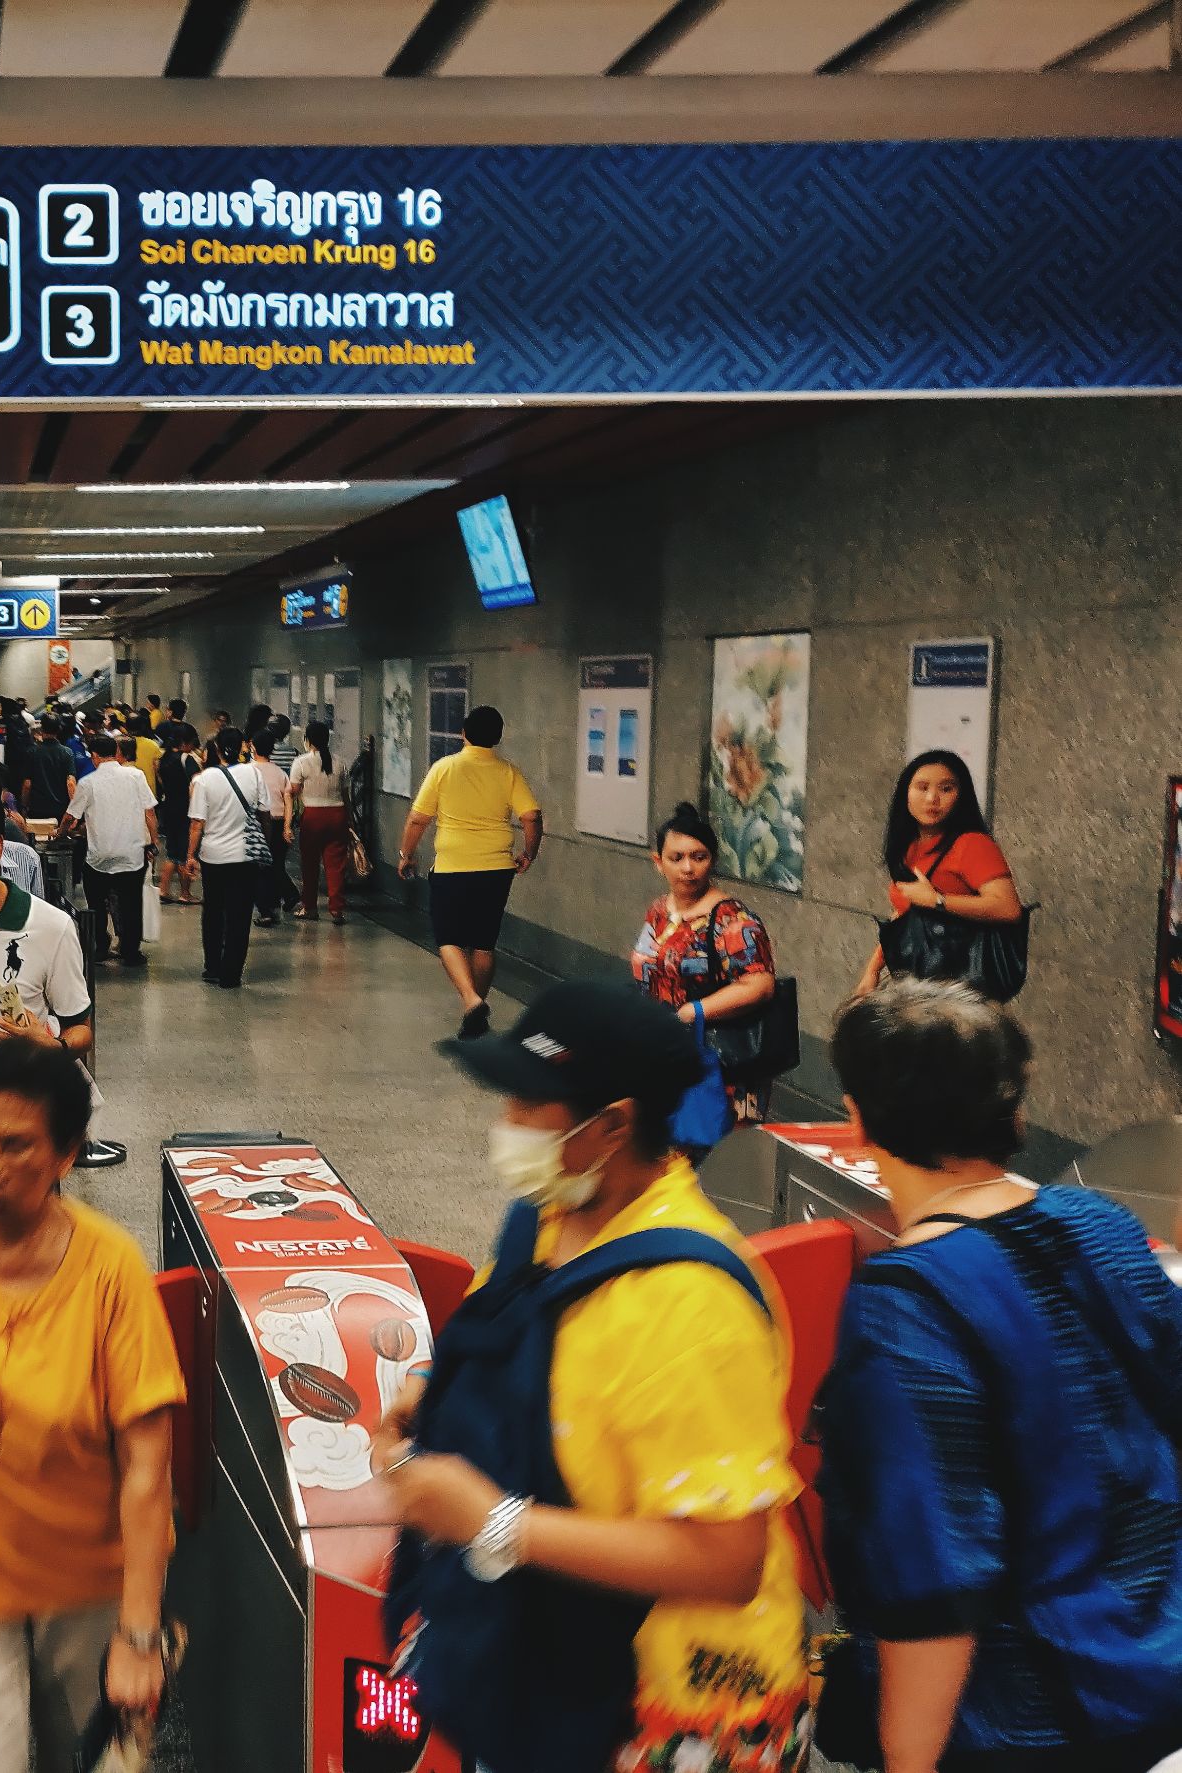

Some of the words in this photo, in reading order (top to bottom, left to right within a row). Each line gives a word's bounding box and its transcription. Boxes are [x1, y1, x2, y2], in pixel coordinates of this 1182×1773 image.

[63, 203, 94, 246] 2
[139, 179, 382, 245] ซอยเจริญกรุง
[398, 187, 442, 226] 16
[139, 239, 186, 264] Soi
[191, 238, 307, 264] Charoen
[313, 239, 396, 271] Krung
[403, 238, 437, 264] 16
[139, 280, 454, 327] วัดมังกรกมลาวาส
[65, 304, 95, 347] 3
[139, 339, 194, 365] Wat
[199, 339, 323, 371] Mangkon
[329, 339, 476, 365] Kamalawat
[234, 1236, 373, 1253] NESCAFÉ
